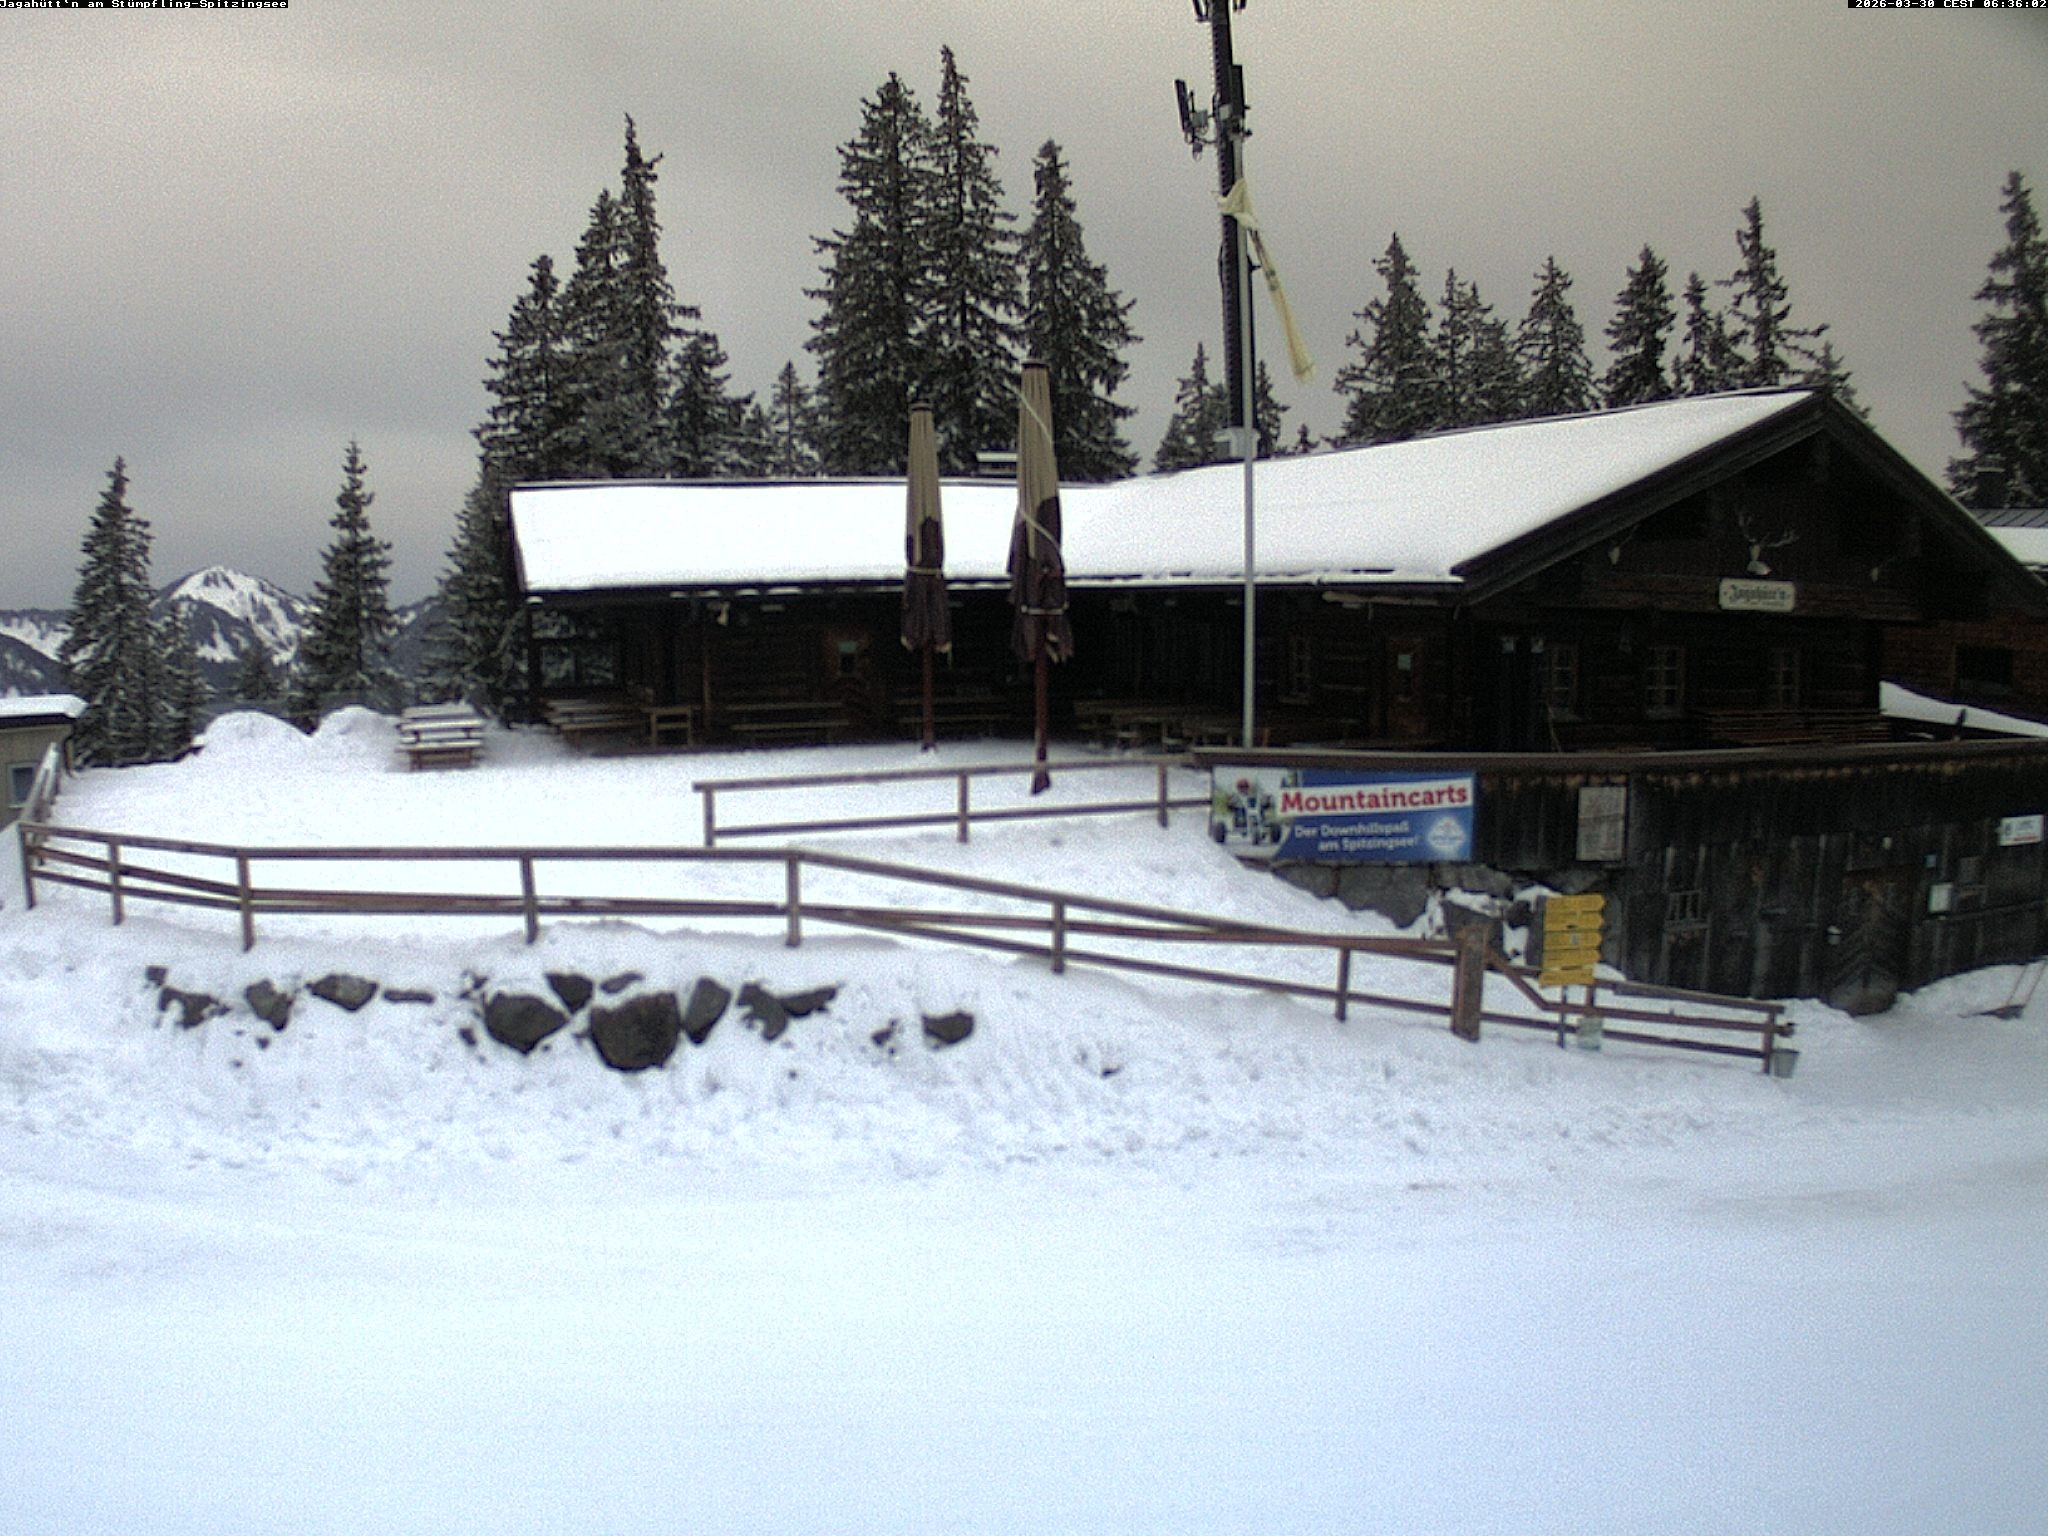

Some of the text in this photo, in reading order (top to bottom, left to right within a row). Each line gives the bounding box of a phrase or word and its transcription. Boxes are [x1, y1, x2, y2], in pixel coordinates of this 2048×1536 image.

[1280, 786, 1467, 813] Mountaincarts
[1295, 824, 1318, 838] Der
[1318, 840, 1341, 852] am
